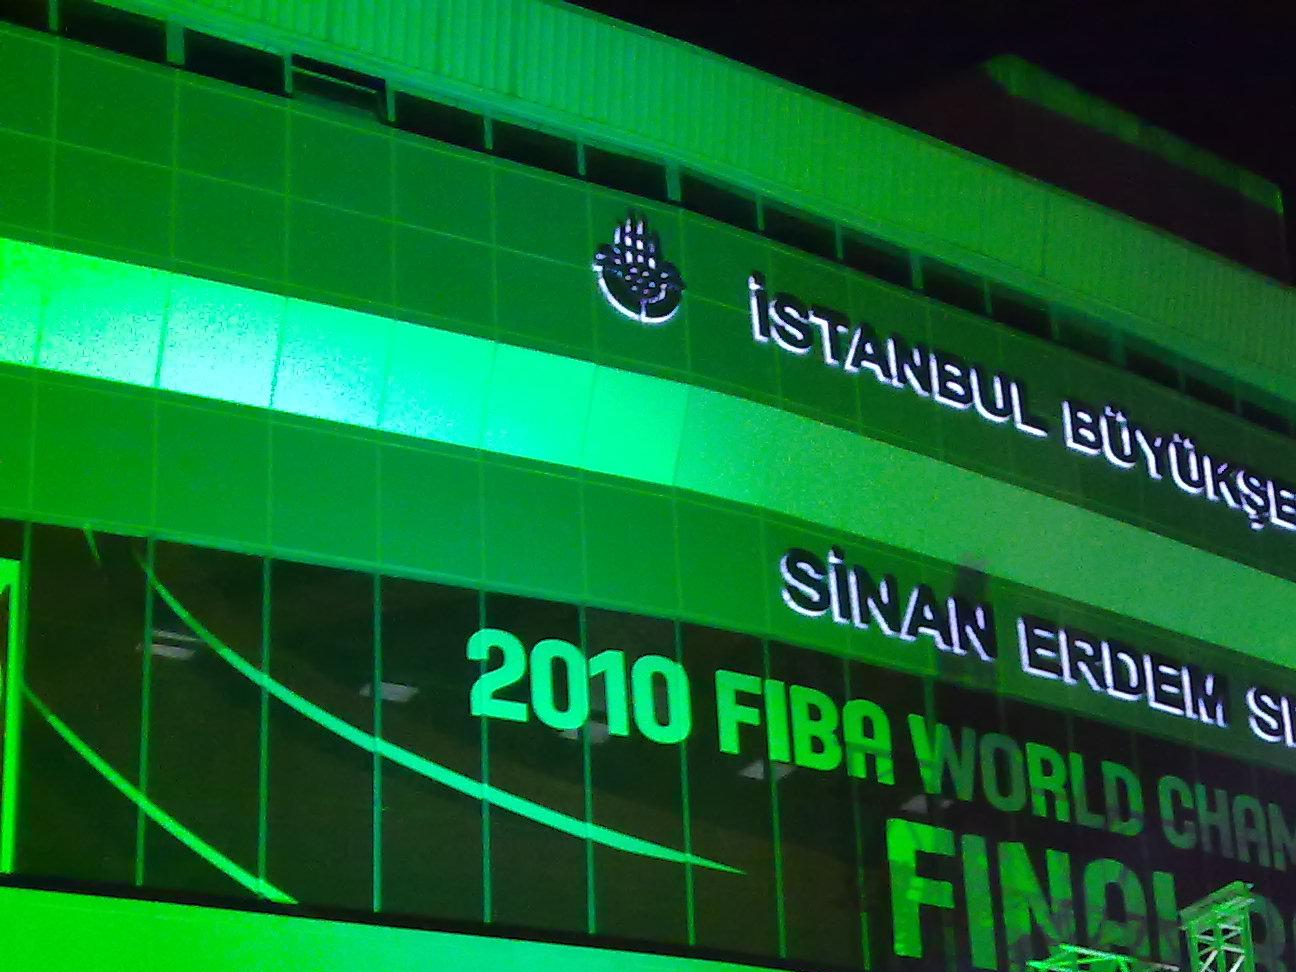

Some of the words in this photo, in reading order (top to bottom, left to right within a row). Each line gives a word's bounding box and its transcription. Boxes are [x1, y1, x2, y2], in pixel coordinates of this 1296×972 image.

[747, 272, 1048, 437] İSTANBUL
[779, 545, 999, 662] SİNAN
[1016, 616, 1230, 728] ERDEM
[466, 628, 692, 744] 2010
[715, 669, 895, 785] FIBA
[907, 713, 1145, 836] WORLD
